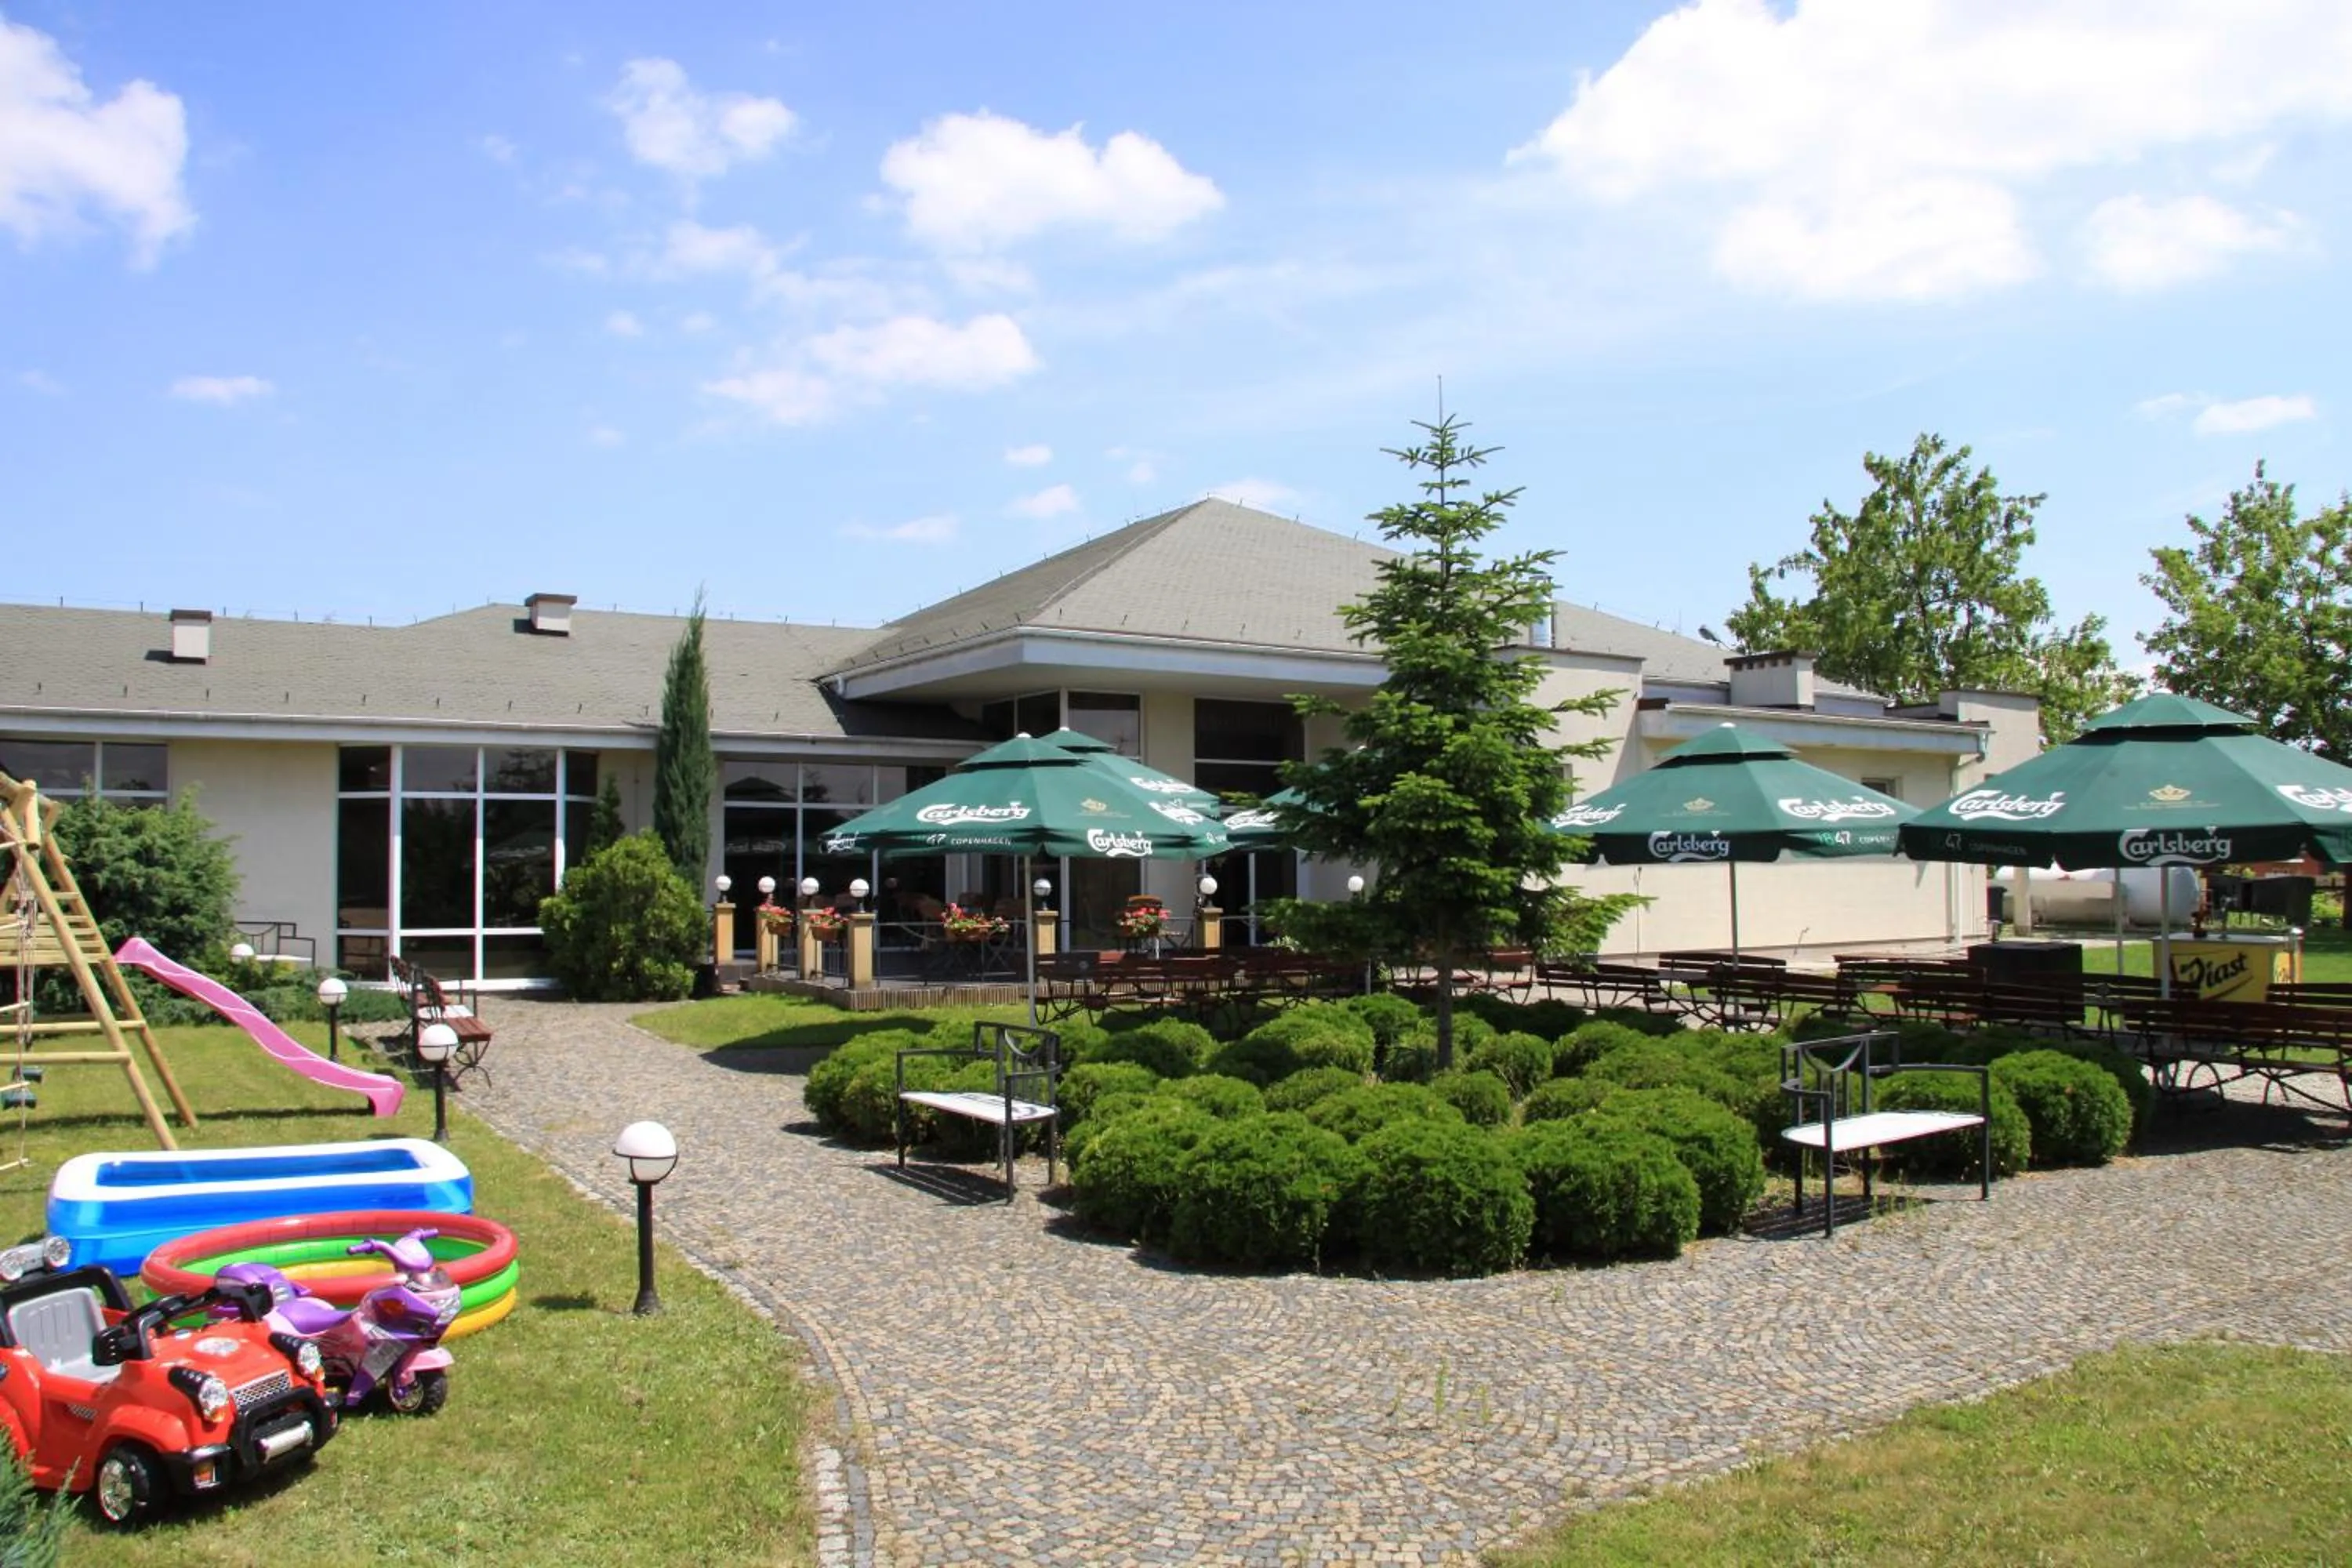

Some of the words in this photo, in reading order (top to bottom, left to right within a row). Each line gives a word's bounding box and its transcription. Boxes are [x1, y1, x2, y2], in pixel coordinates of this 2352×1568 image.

[1777, 796, 1896, 822] Carlsberg
[1948, 789, 2066, 821] Carlsberg
[2274, 785, 2352, 812] Carls
[916, 800, 1032, 826] Carlsberg
[1087, 829, 1152, 857] Carlsberg
[1648, 830, 1730, 862] Carlsberg
[2118, 826, 2232, 866] Carlsberg
